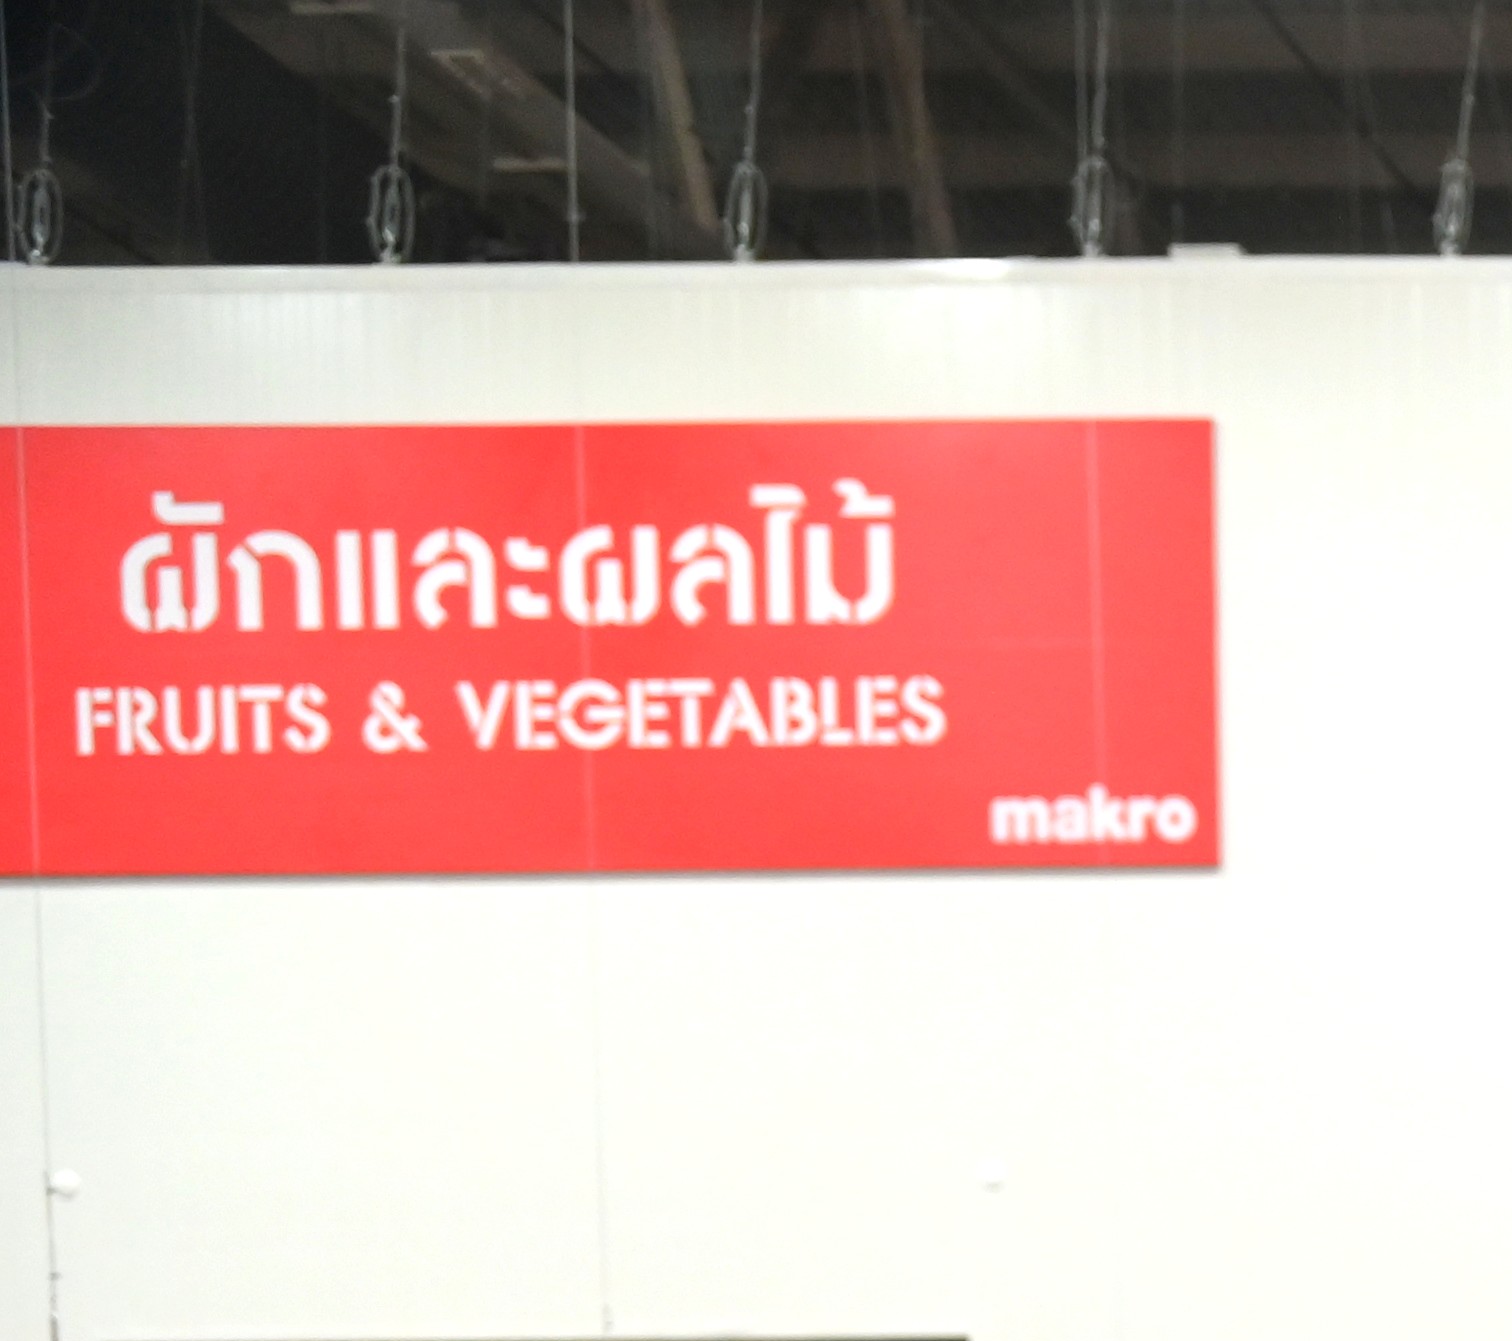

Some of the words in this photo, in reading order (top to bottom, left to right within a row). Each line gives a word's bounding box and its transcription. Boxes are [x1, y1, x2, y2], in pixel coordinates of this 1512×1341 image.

[120, 479, 896, 634] ผักและผลไม้
[76, 682, 331, 756] FRUITS
[363, 685, 427, 751] &
[457, 675, 949, 749] VEGETABLES
[990, 784, 1197, 843] makro
